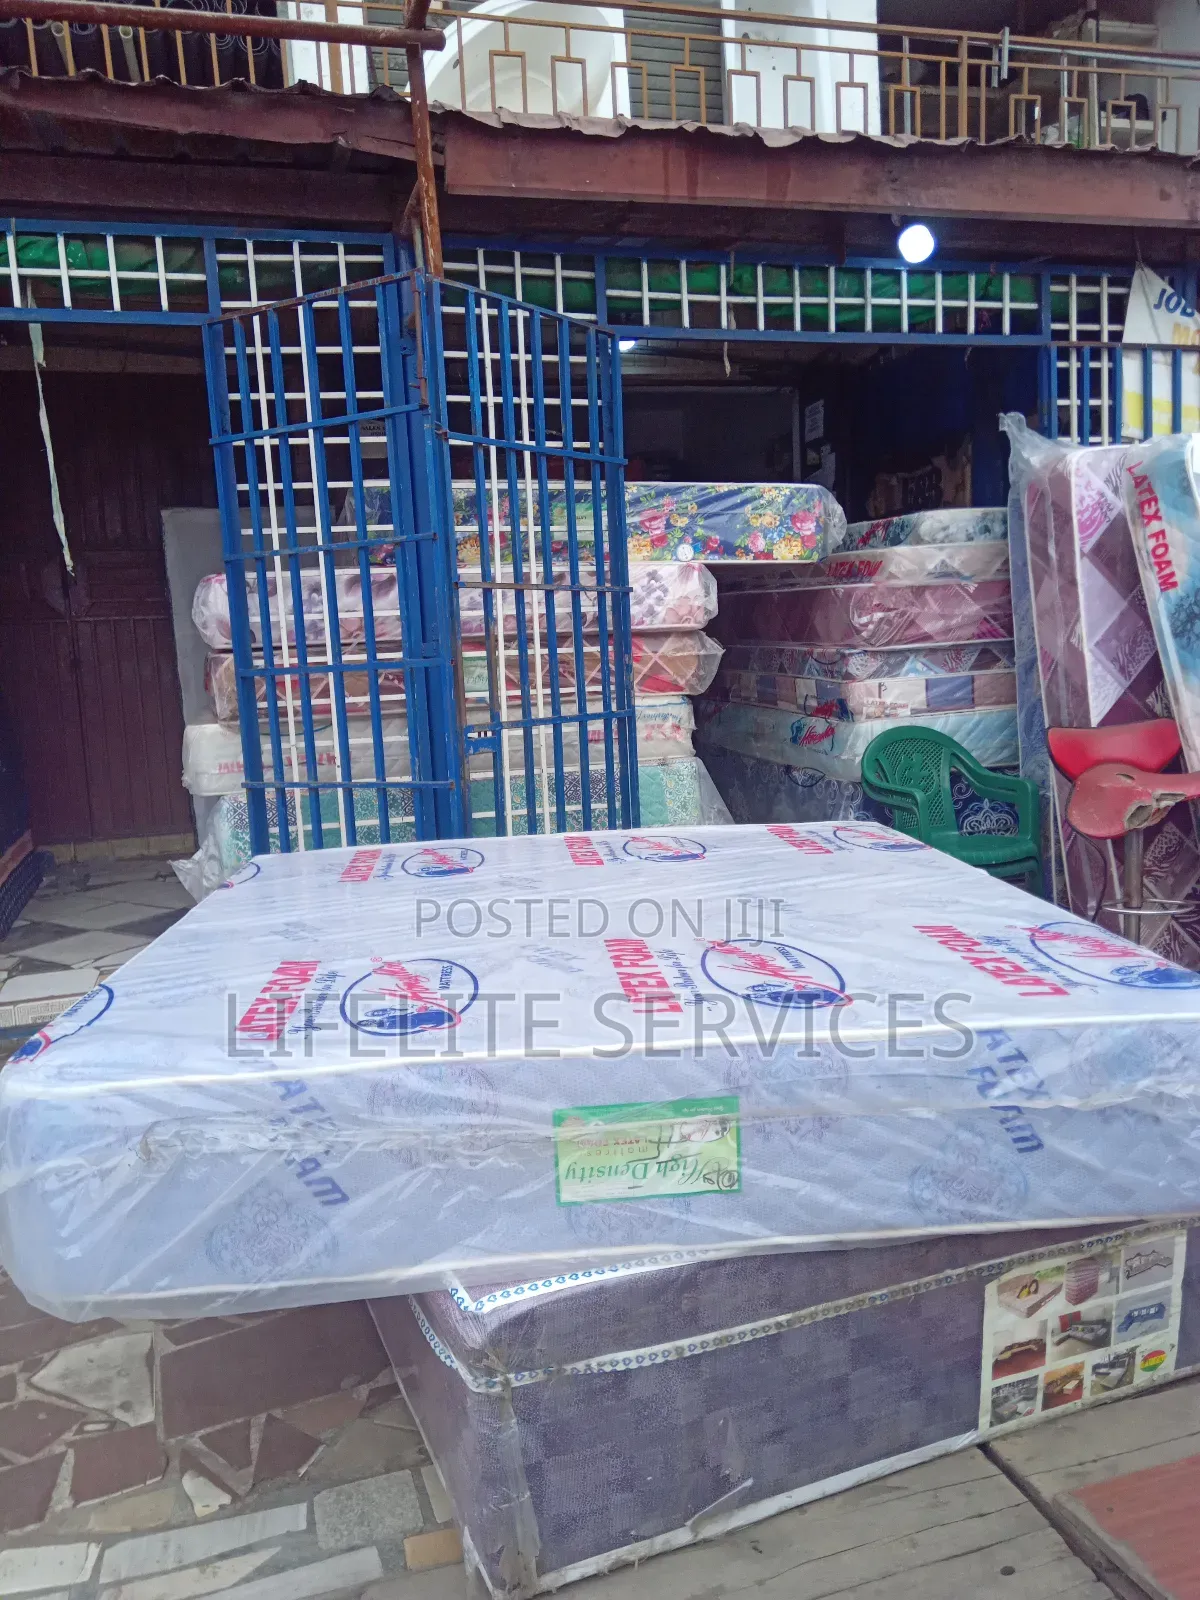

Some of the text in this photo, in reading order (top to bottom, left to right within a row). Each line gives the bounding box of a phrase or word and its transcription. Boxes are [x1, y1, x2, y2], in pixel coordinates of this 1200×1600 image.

[1126, 461, 1178, 592] LATEX FOAM
[603, 938, 659, 969] FOAM
[912, 925, 1070, 997] LATEX FOAM
[234, 960, 322, 1041] LATEX FOAM
[616, 972, 684, 1014] LATEX
[976, 1028, 1051, 1101] ATEX
[565, 1160, 650, 1184] Density
[656, 1153, 732, 1186] High
